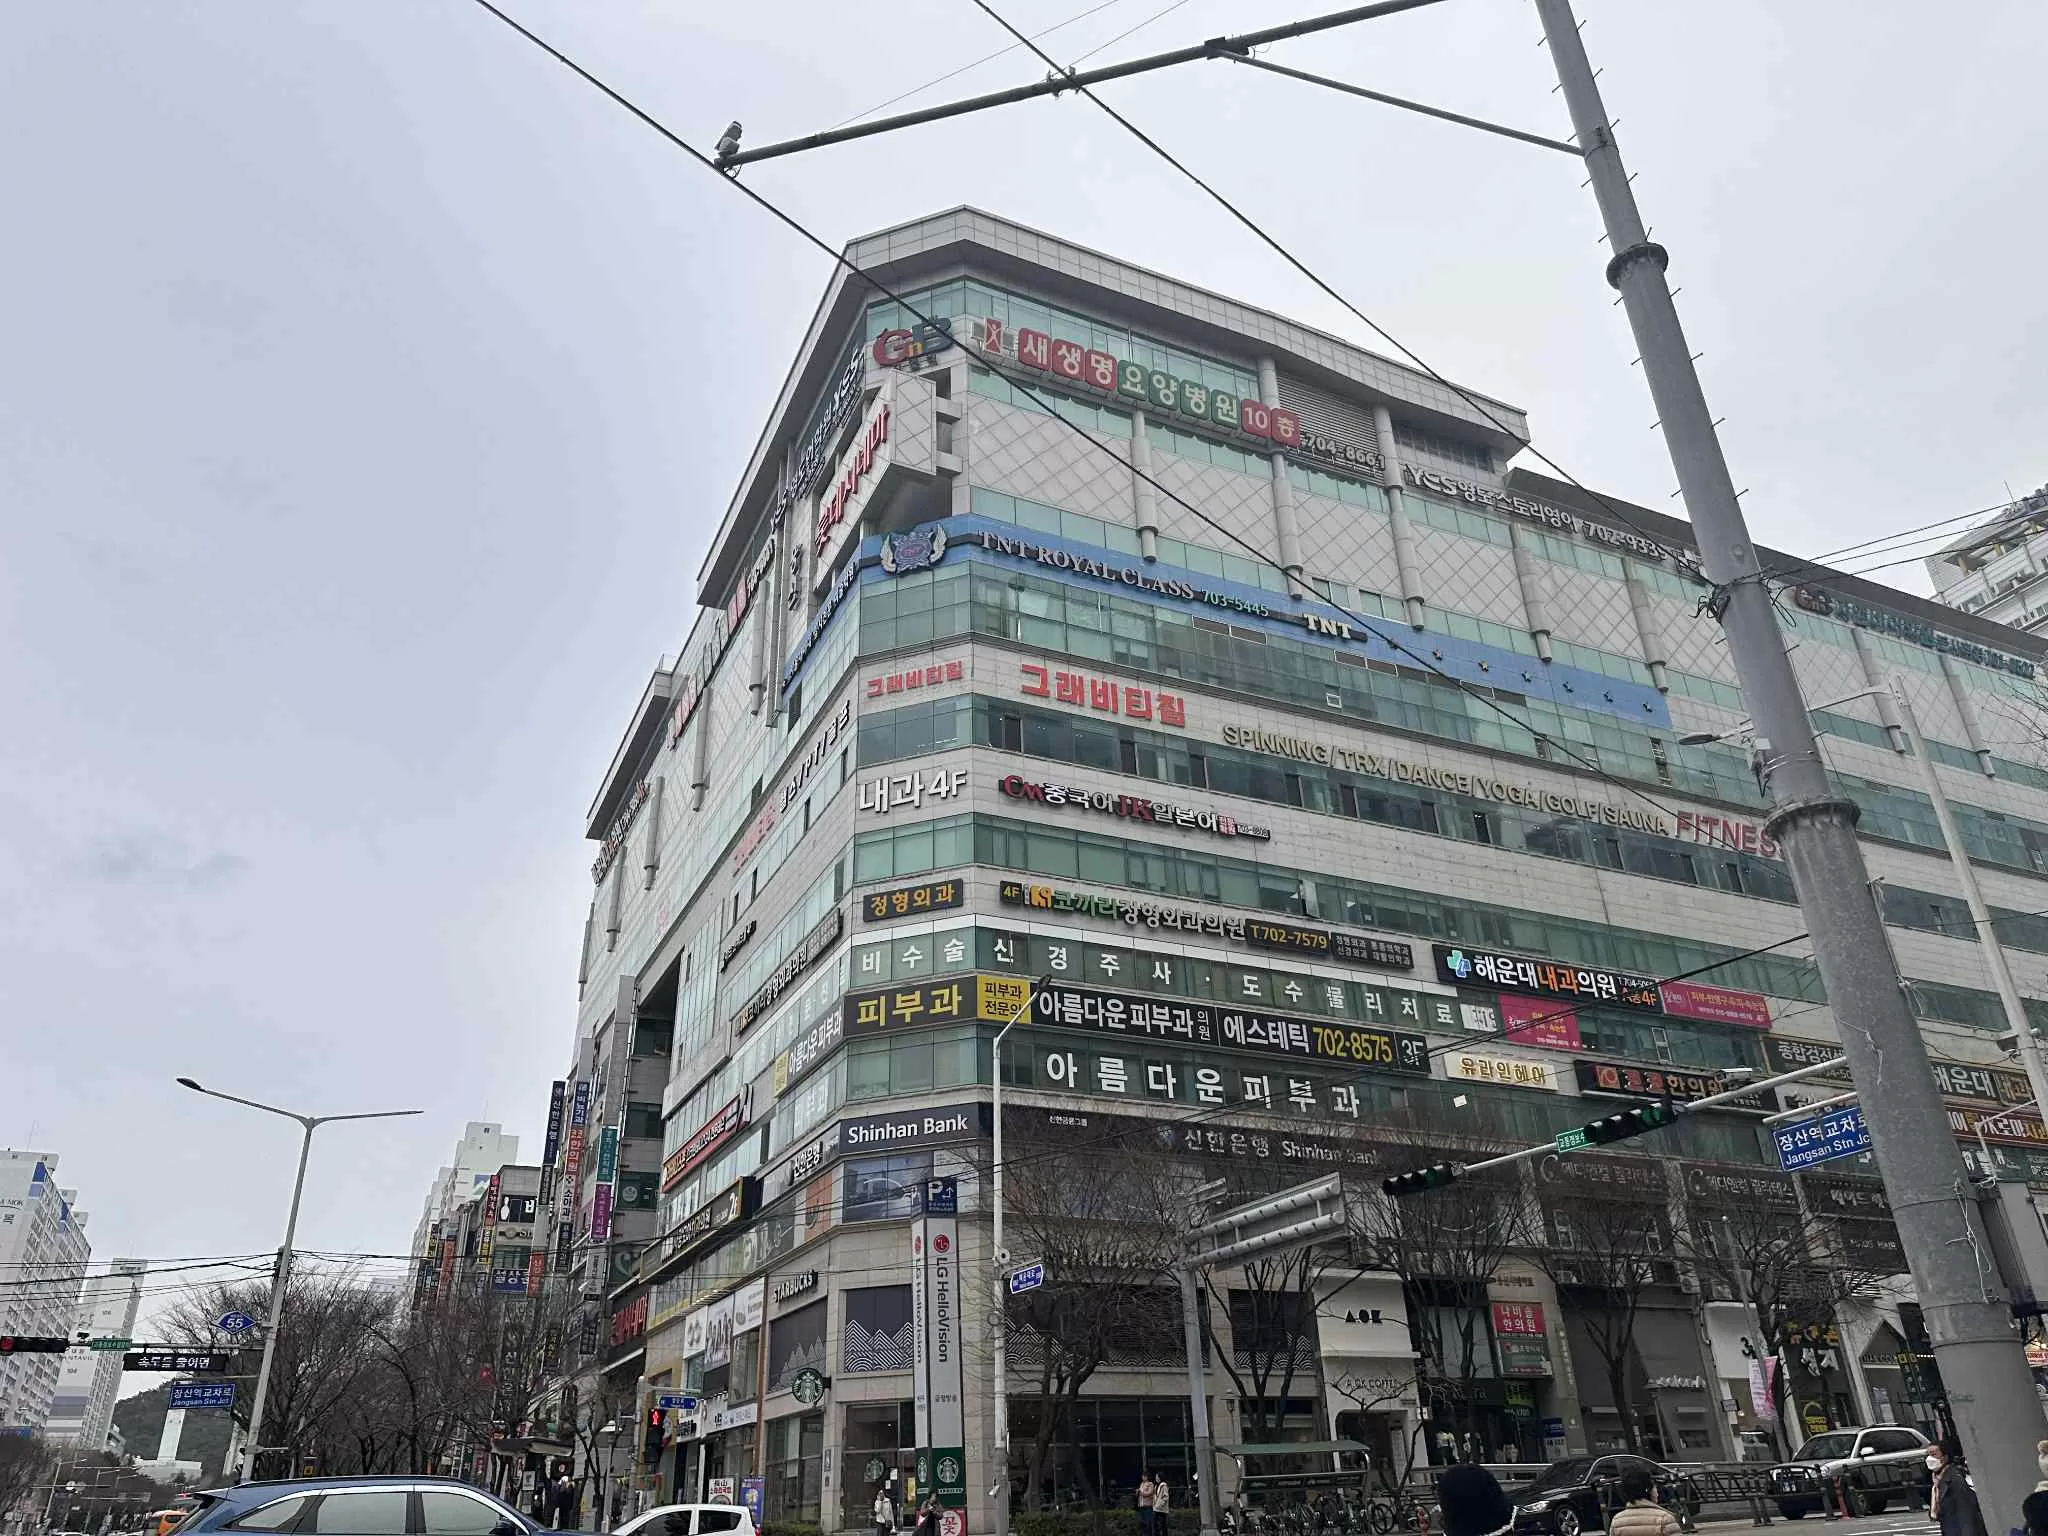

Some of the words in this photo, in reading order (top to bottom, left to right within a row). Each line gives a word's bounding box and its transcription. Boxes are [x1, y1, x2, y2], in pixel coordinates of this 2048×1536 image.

[1306, 432, 1386, 470] 704-8661
[976, 527, 1028, 558] TNT
[1033, 544, 1117, 583] ROYAL
[1120, 565, 1195, 602] CLASS
[1201, 587, 1270, 618] 703-5445
[1303, 612, 1354, 641] TNT
[858, 770, 926, 814] 내과
[927, 768, 968, 800] 4F
[870, 883, 956, 917] 정형외과
[1003, 885, 1020, 899] 4F
[984, 980, 1023, 999] 피부과
[1473, 954, 1618, 999] 해운대내과의원
[855, 983, 963, 1027] 피부과
[984, 999, 1022, 1017] 전문의
[1039, 991, 1194, 1038] 아름다운피부과
[1223, 1015, 1311, 1054] 에스테틱
[788, 1004, 842, 1074] 아름다운피부과
[1046, 1051, 1361, 1120] 아름다운피부과
[848, 1122, 918, 1144] Shinhan
[923, 1113, 968, 1135] Bank
[1184, 1127, 1270, 1158] 신한은행
[1281, 1139, 1343, 1162] Shinhan
[1784, 1142, 1832, 1166] Jangsan
[1833, 1135, 1856, 1153] Stn
[936, 1257, 948, 1279] LG
[773, 1271, 814, 1304] STARBUCKS
[226, 1318, 243, 1329] 55
[936, 1282, 948, 1364] HelloVision
